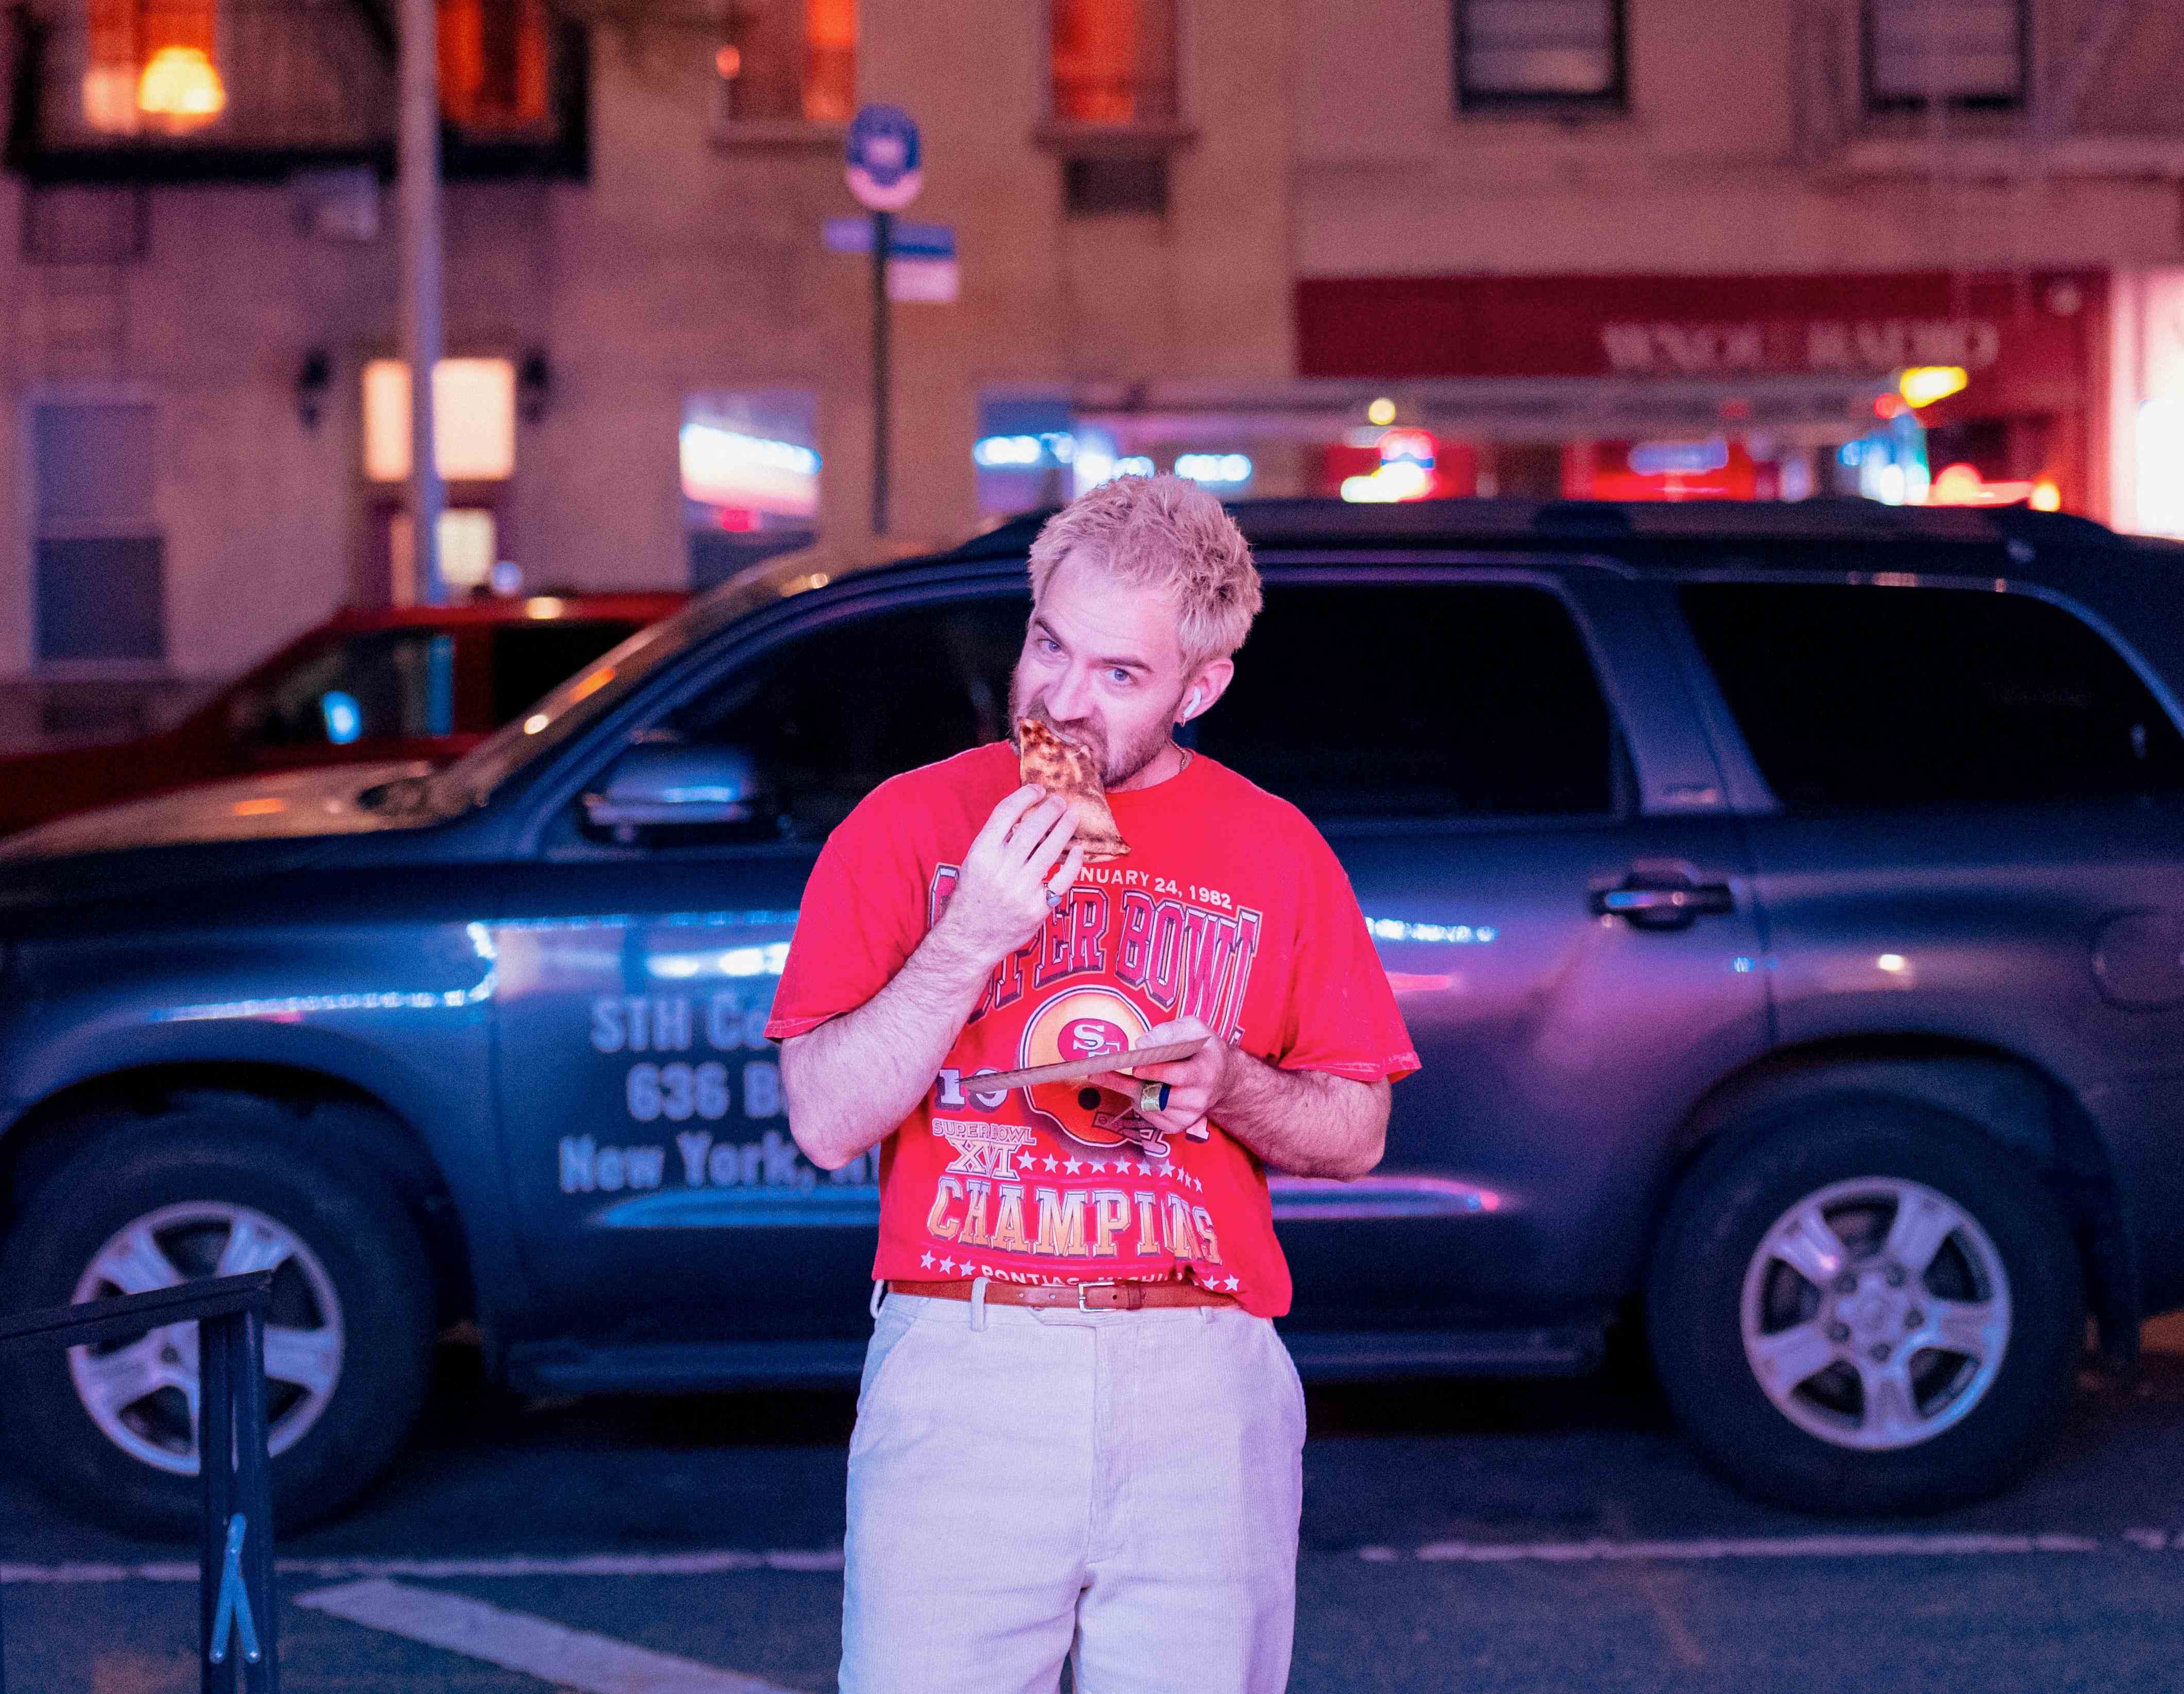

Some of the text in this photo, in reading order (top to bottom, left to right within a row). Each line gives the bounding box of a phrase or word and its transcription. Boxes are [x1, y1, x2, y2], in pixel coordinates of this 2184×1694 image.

[1074, 866, 1232, 910] NUARY 24, 1982
[626, 1061, 730, 1121] 636
[932, 1118, 990, 1139] SUPER
[558, 1133, 665, 1194] New
[945, 1136, 1021, 1181] XVI
[926, 1176, 1224, 1266] CHAMPINS
